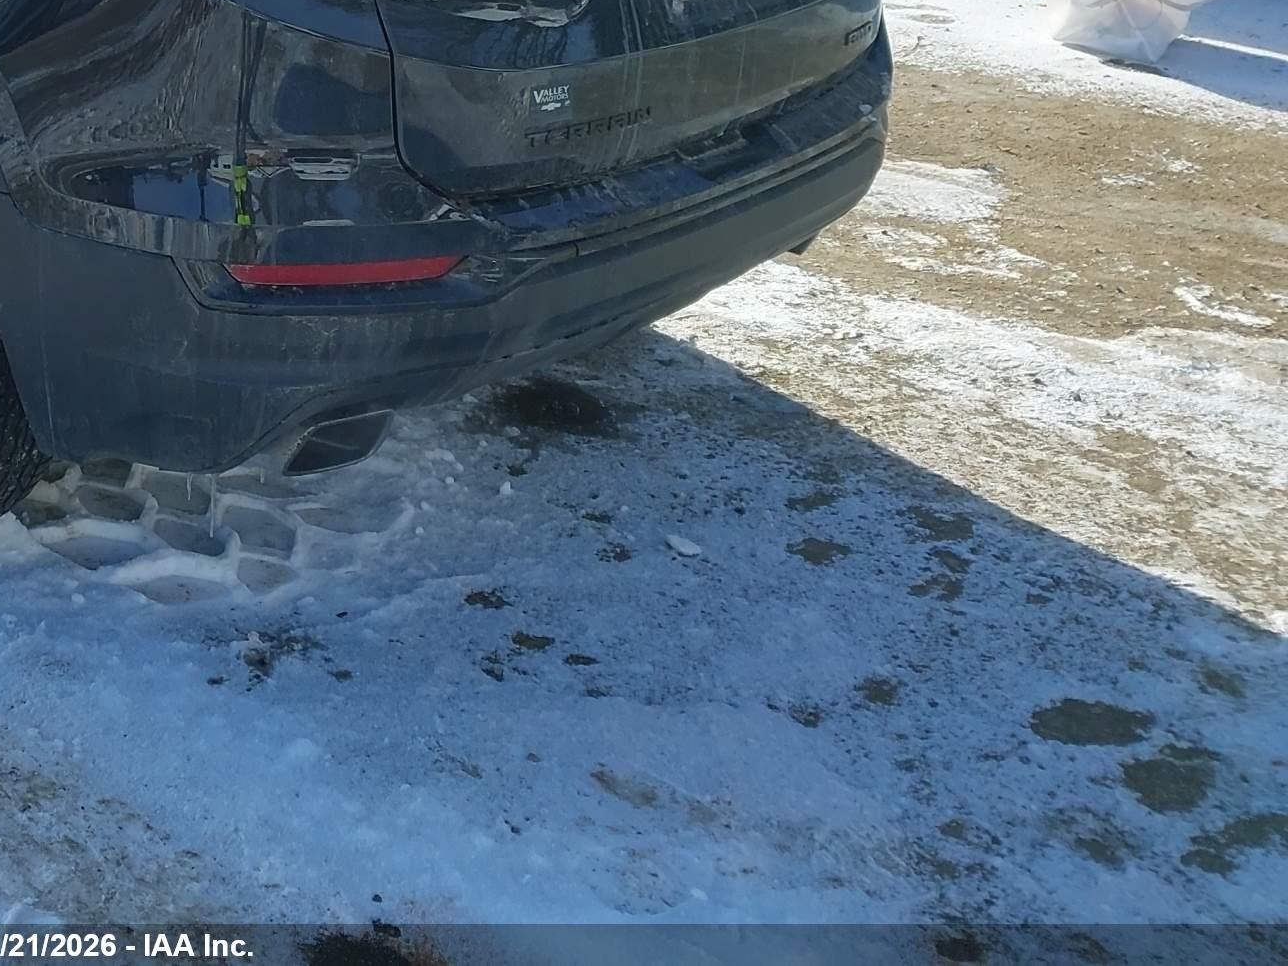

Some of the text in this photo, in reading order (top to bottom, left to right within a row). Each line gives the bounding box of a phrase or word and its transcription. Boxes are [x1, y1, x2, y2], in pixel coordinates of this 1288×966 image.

[533, 84, 570, 104] VALLEY
[541, 93, 569, 102] MOTORS
[524, 106, 651, 148] TERRAIN
